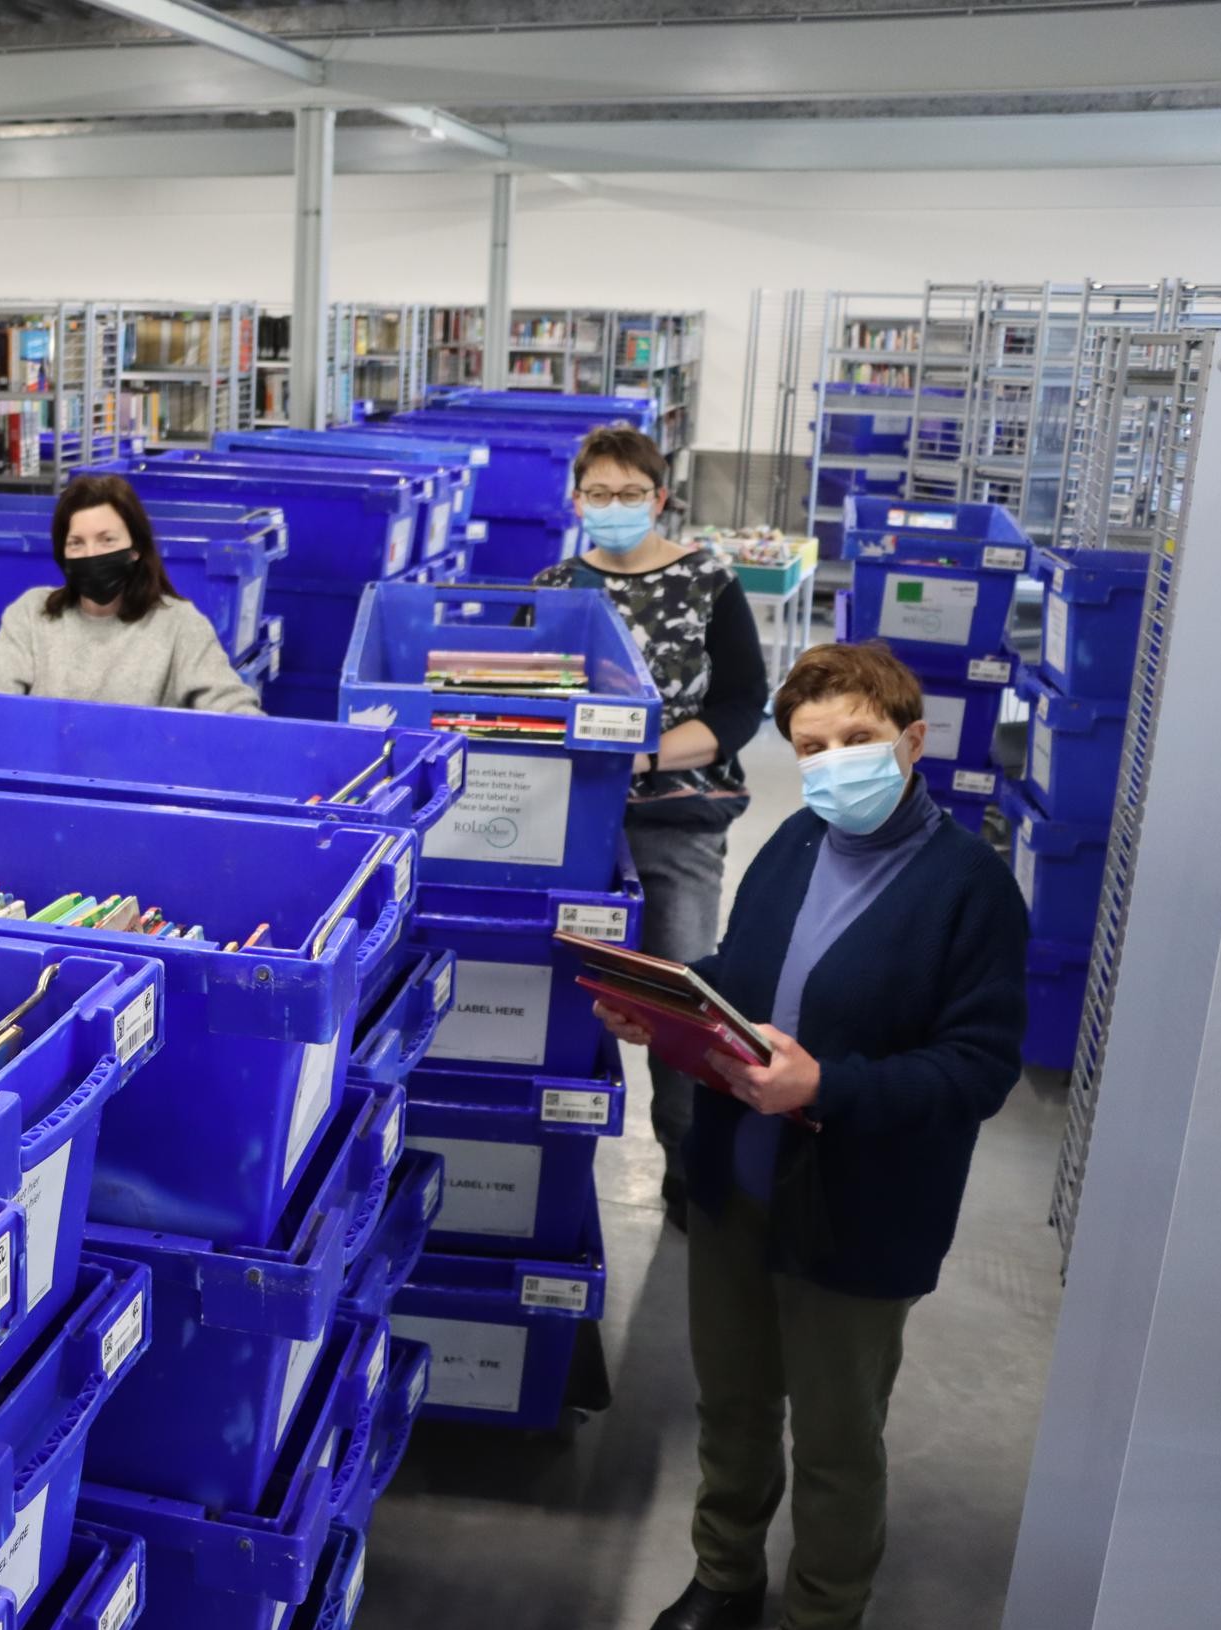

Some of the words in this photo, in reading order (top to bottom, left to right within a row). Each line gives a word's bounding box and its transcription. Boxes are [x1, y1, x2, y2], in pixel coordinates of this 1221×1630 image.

[457, 1003, 492, 1014] LABEL
[495, 1006, 525, 1017] HERE
[450, 1179, 484, 1190] LABEL
[9, 1523, 30, 1559] HERE
